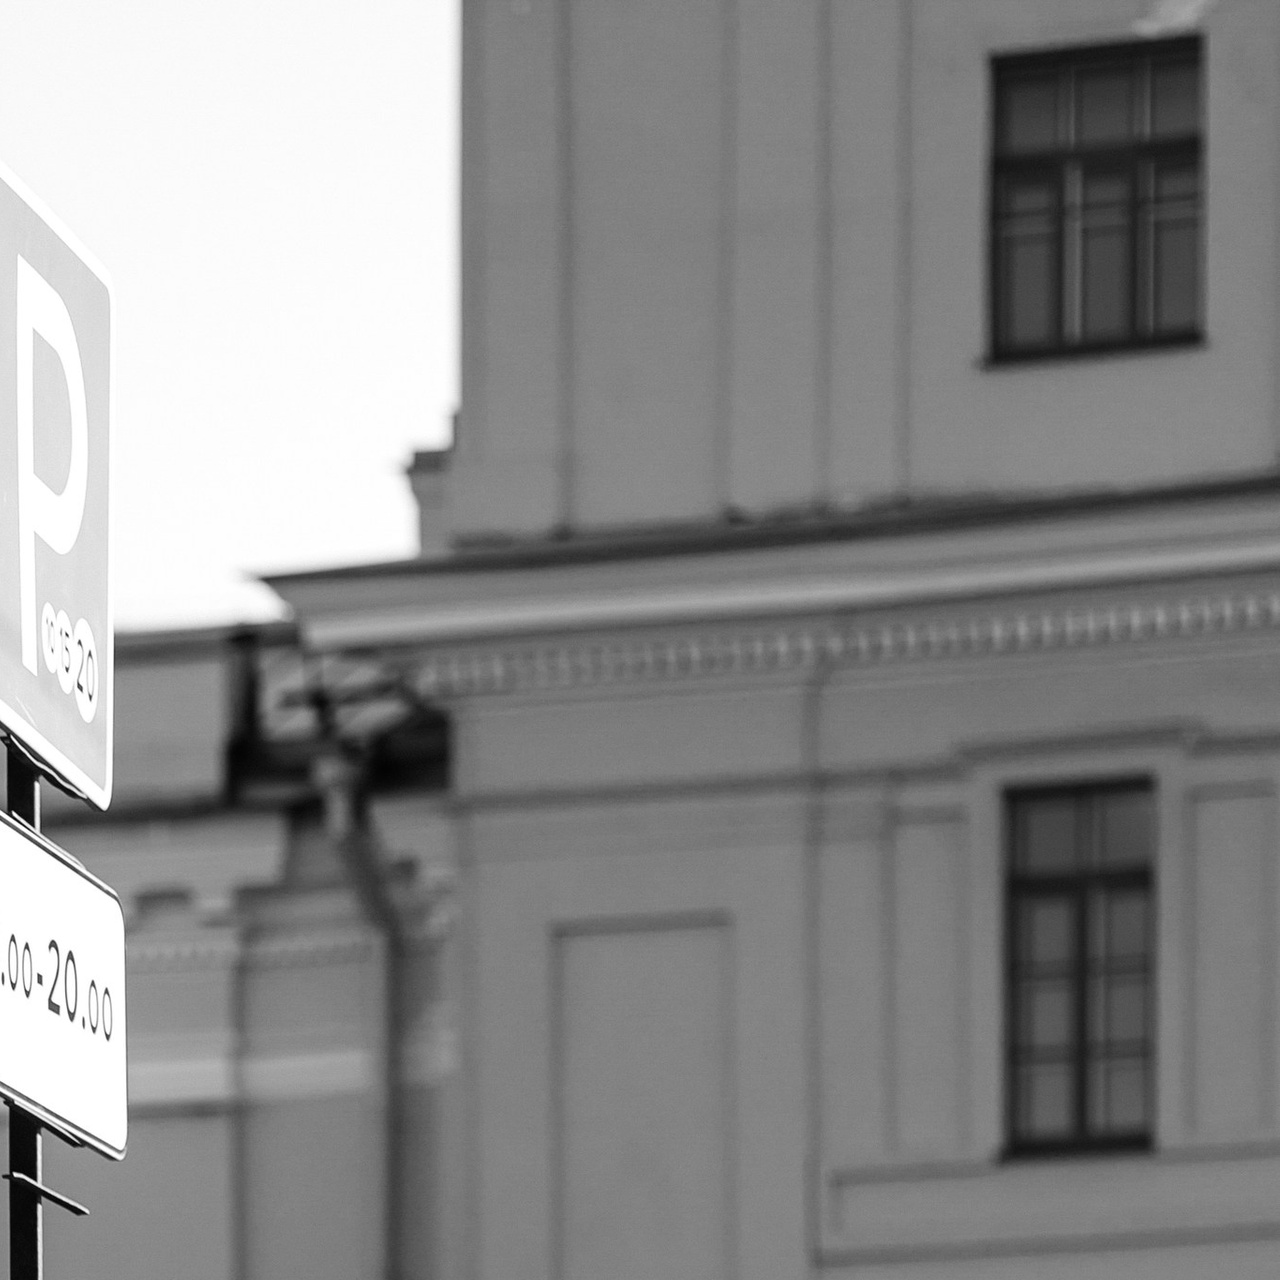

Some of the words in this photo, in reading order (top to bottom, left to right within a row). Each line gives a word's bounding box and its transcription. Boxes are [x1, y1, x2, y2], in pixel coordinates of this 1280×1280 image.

[16, 253, 89, 677] P
[60, 628, 71, 673] 15
[77, 639, 95, 702] 20
